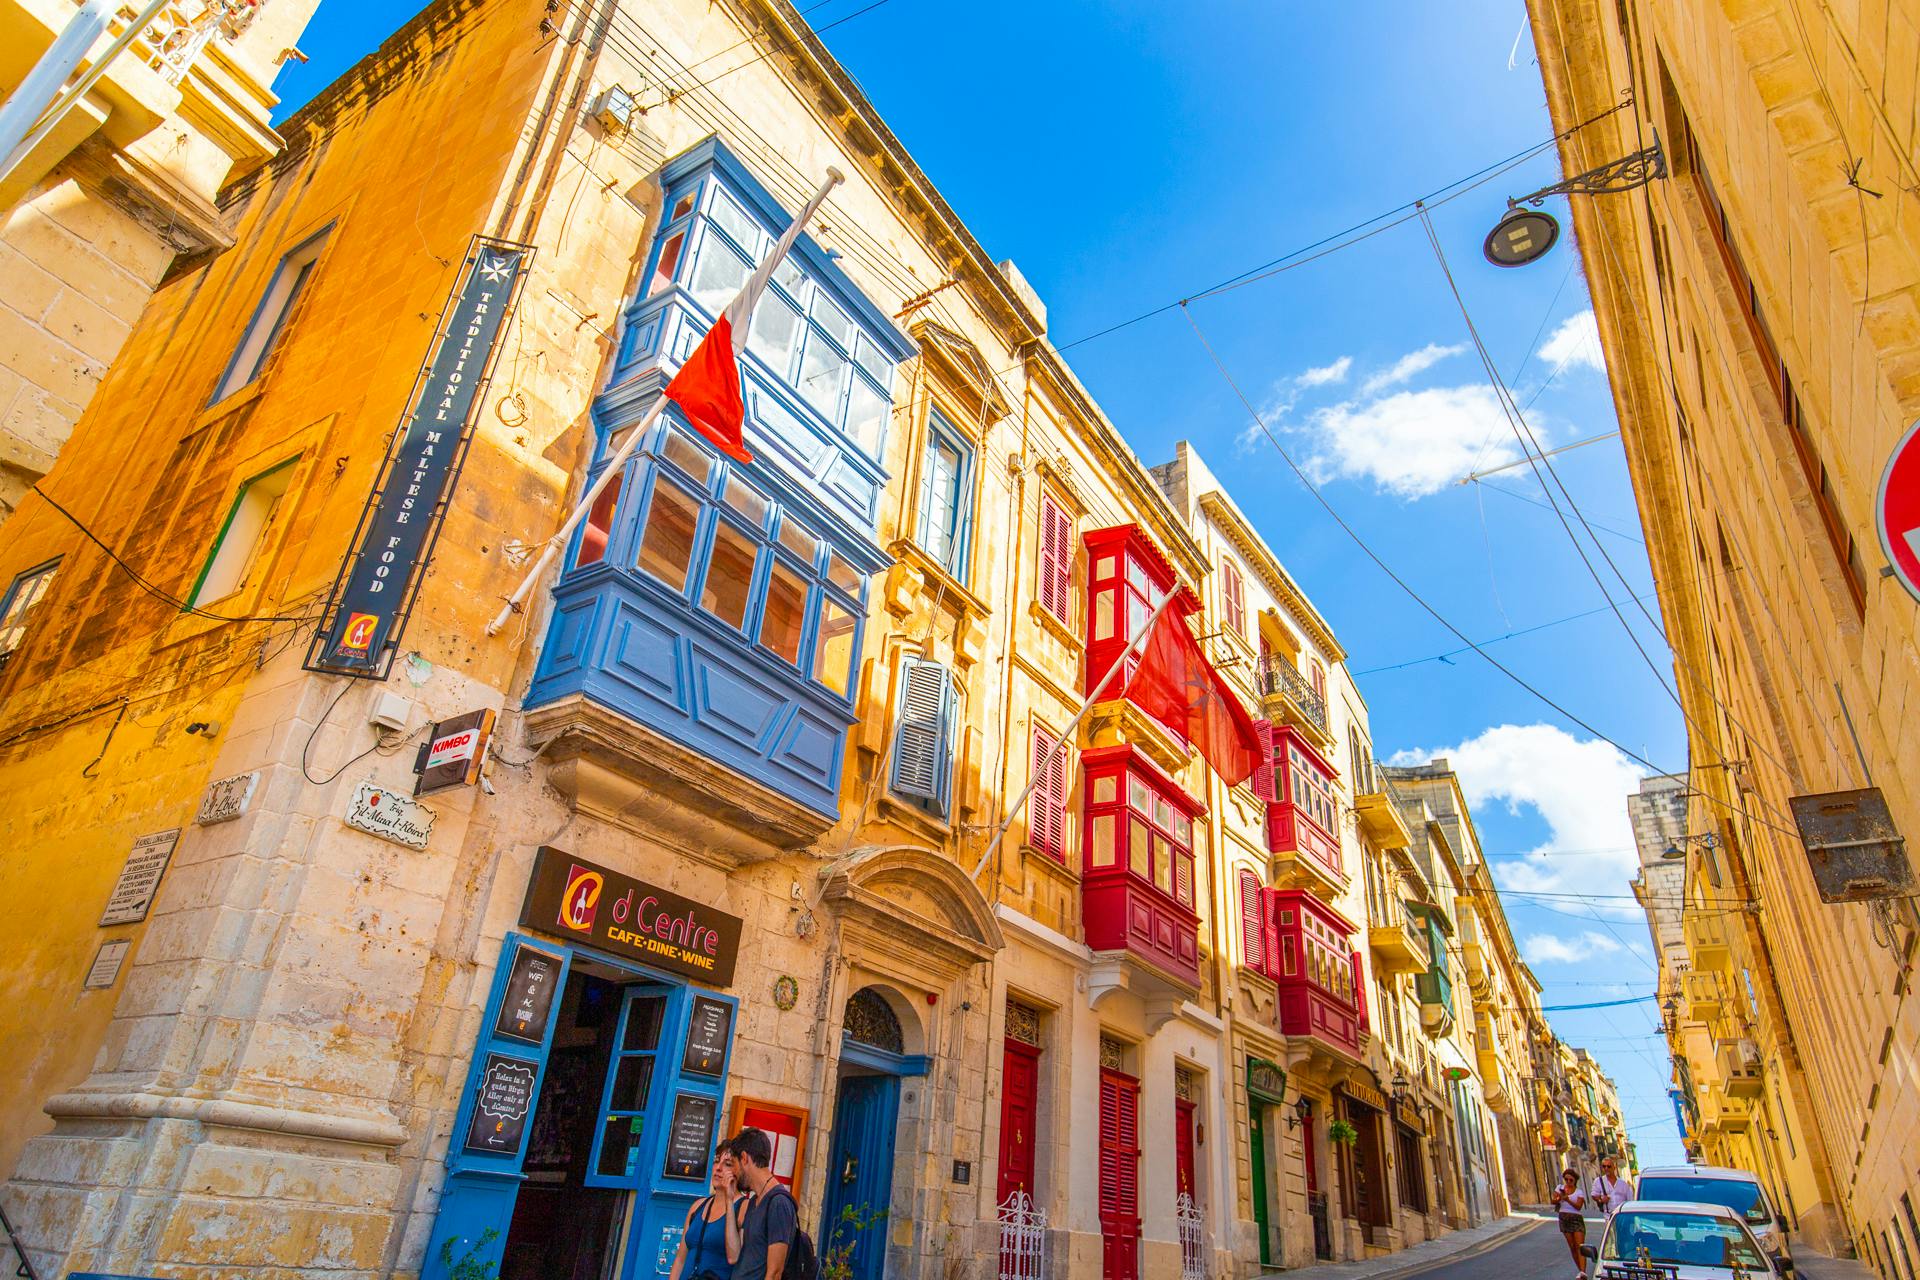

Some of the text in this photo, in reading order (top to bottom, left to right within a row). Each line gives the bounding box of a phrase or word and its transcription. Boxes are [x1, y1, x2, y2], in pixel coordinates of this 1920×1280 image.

[369, 292, 493, 593] TRADITIONAL MALTESE FOOD
[432, 734, 471, 754] KIMBO
[392, 817, 424, 838] l-Kbira
[612, 888, 719, 956] d Centre
